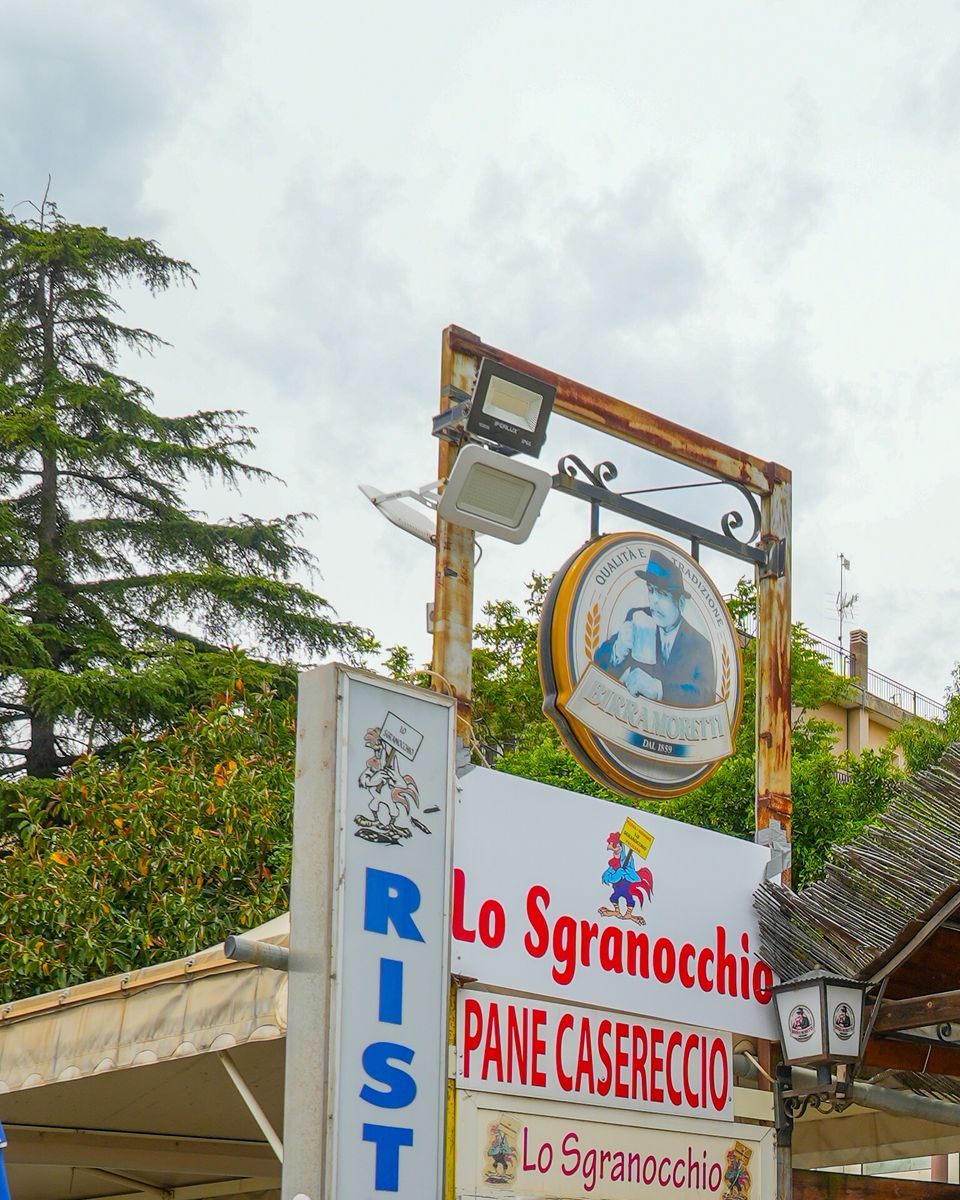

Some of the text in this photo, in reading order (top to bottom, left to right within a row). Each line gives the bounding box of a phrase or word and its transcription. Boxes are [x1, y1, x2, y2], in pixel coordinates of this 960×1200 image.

[595, 546, 647, 586] QUALITÀ E
[671, 557, 724, 627] TRADIZIONE
[642, 738, 673, 754] DAL 1859
[452, 867, 774, 1005] Lo Sgranocchio
[463, 998, 728, 1112] PANE CASERECCIO
[522, 1127, 723, 1192] Lo Sgranocchio
